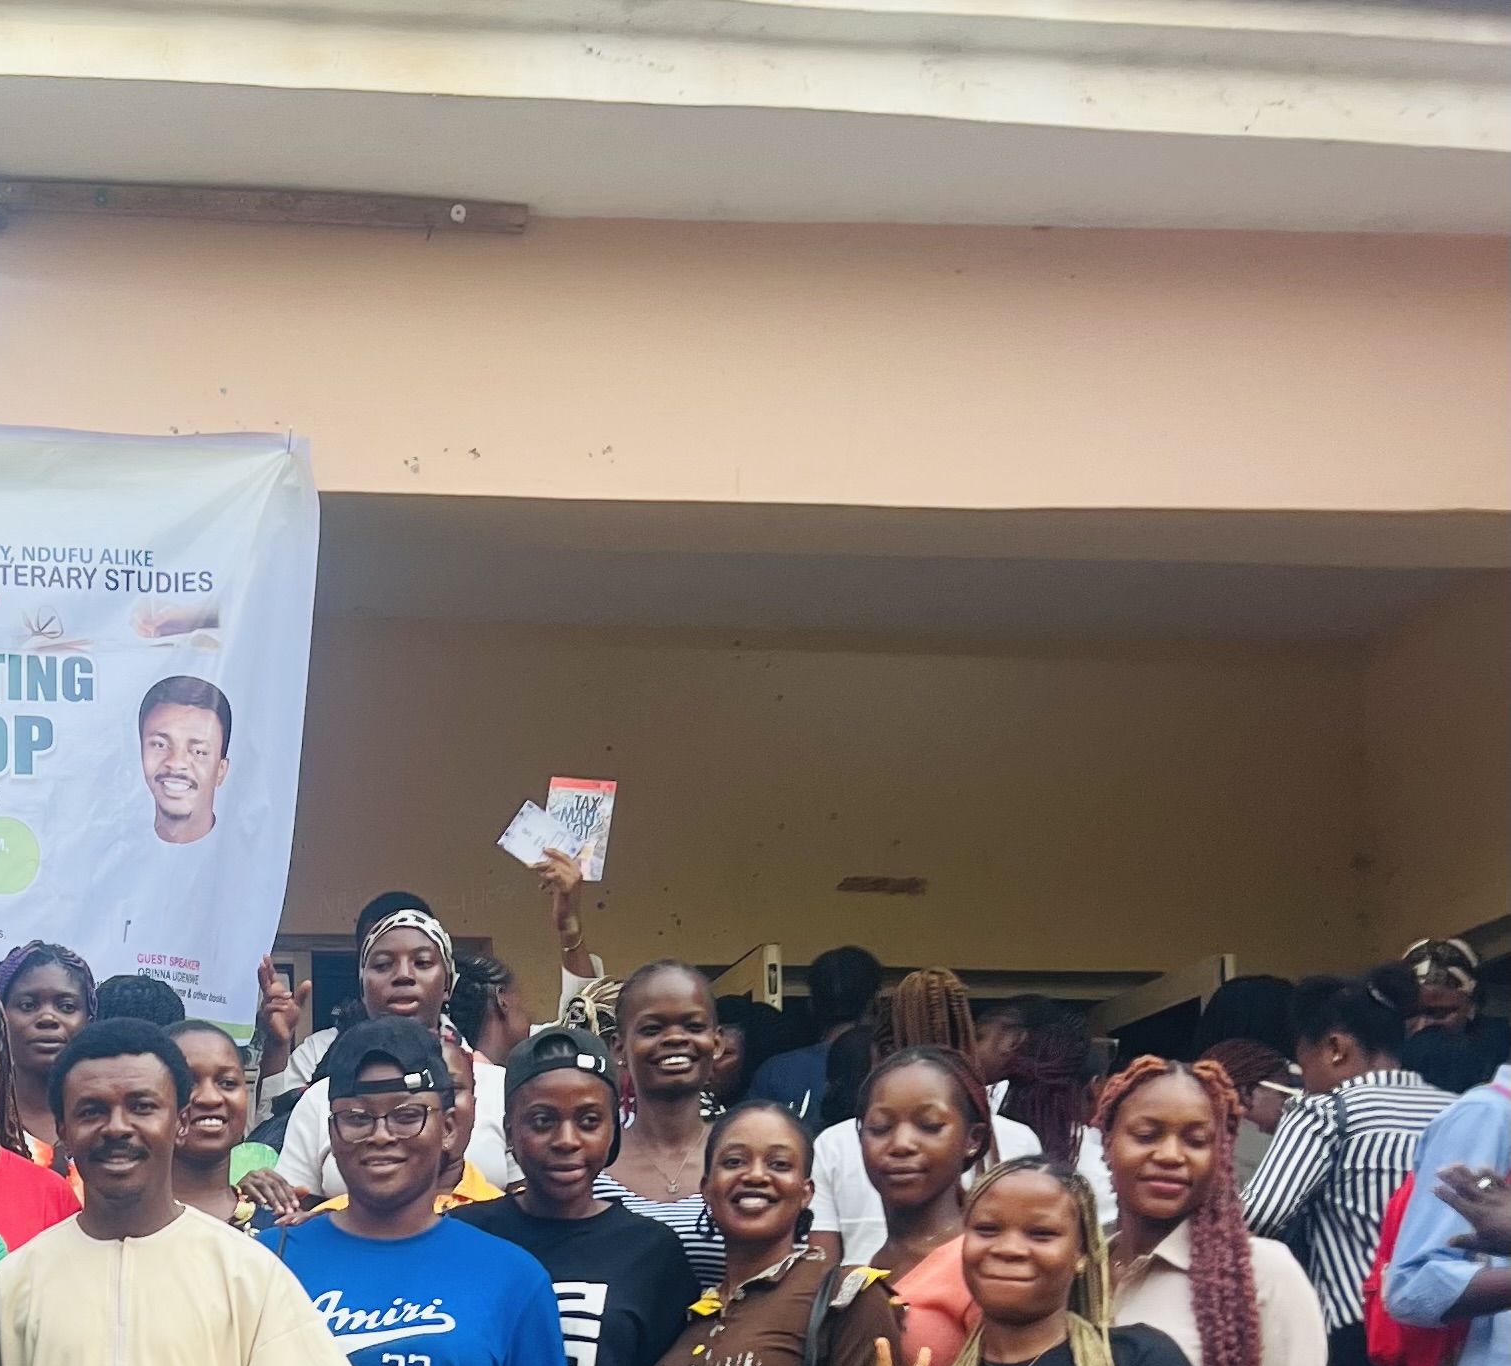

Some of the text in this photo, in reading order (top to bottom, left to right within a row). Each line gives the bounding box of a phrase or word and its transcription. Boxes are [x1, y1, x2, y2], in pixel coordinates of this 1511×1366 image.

[22, 546, 93, 564] NDUFU
[100, 549, 154, 568] ALIKE
[104, 569, 214, 592] STUDIES
[575, 795, 600, 810] TAX
[137, 954, 200, 971] GUEST SPEAKER
[311, 1290, 452, 1338] Amiri
